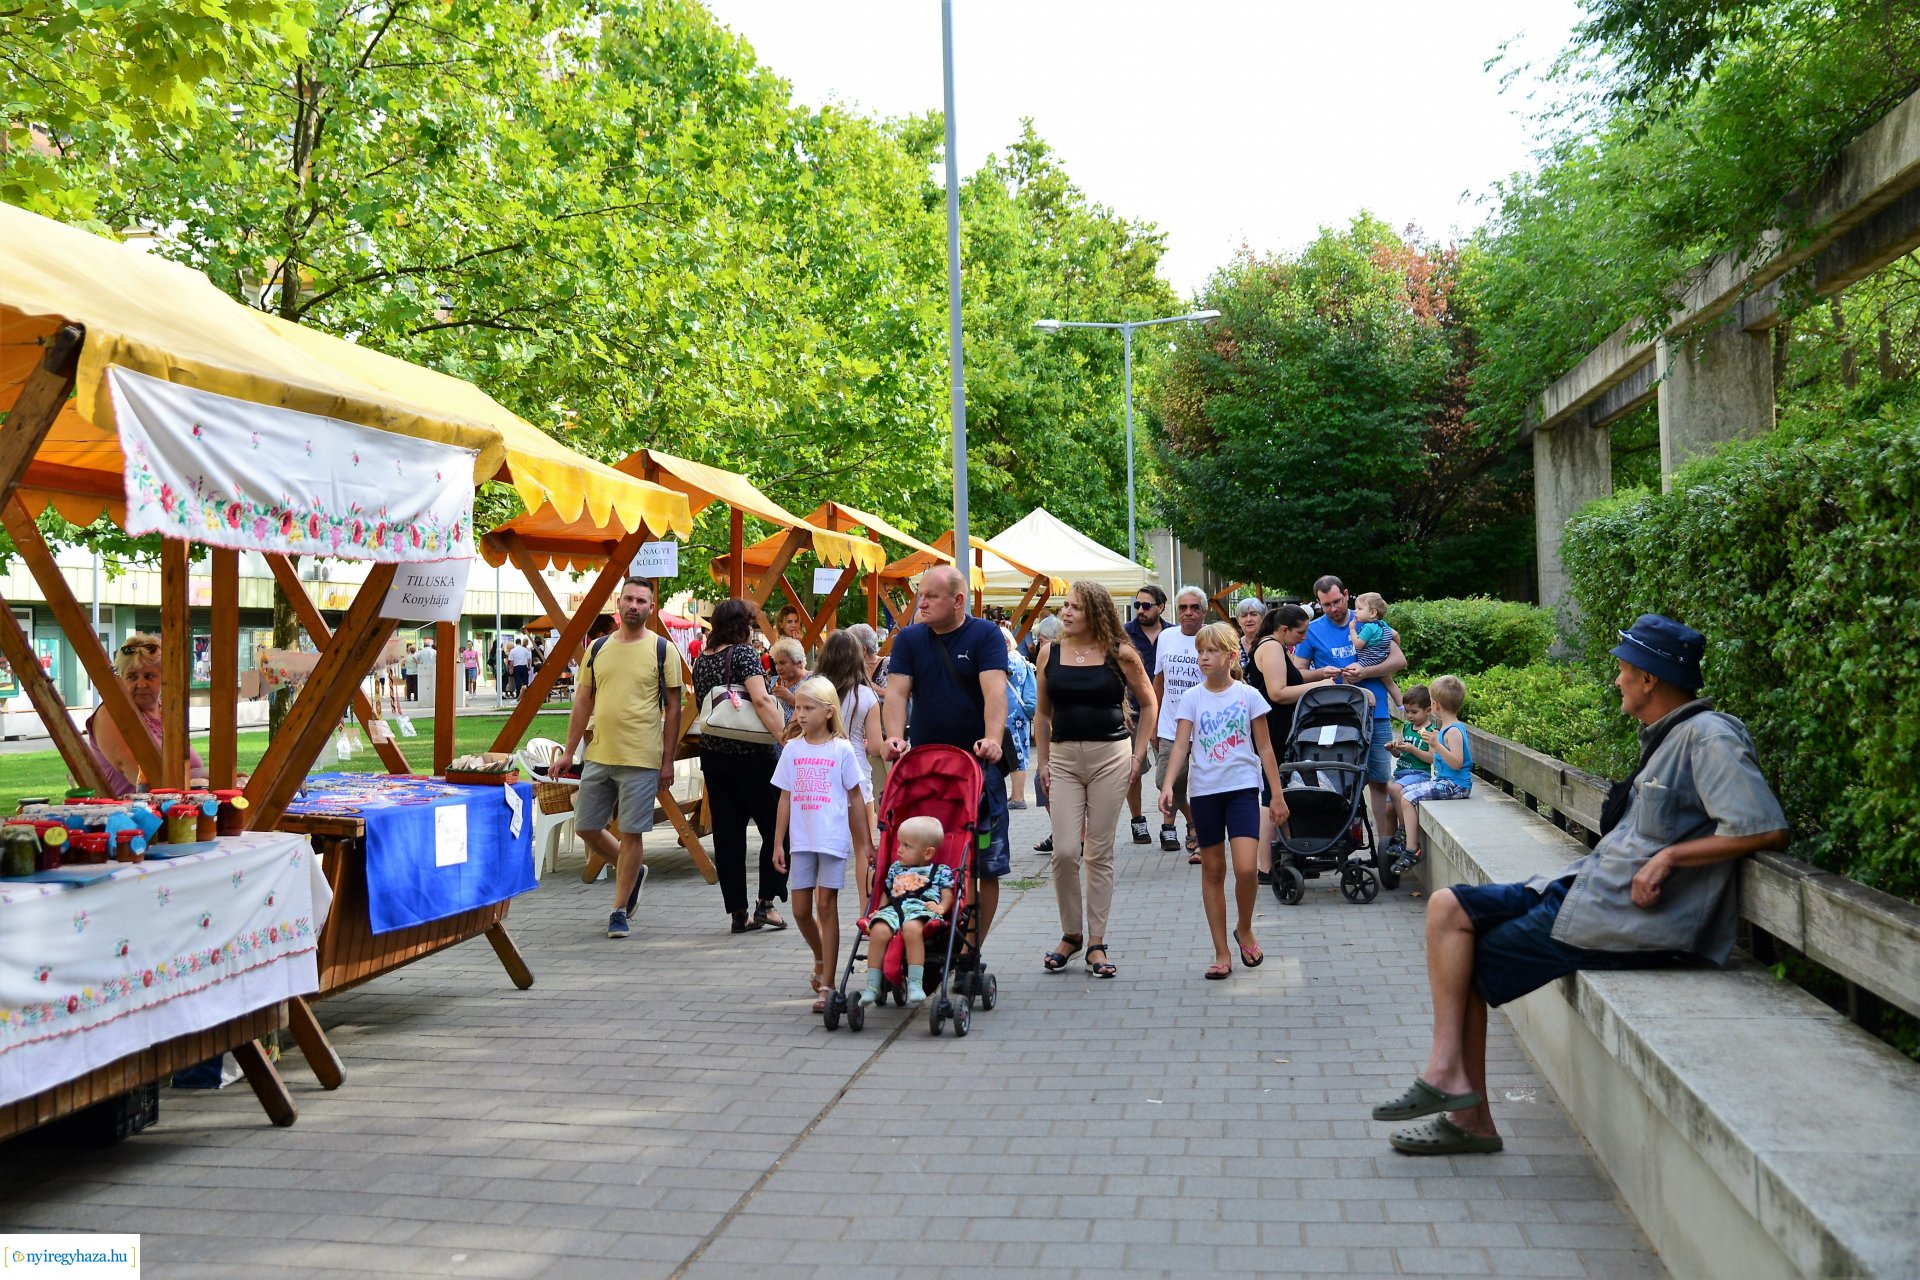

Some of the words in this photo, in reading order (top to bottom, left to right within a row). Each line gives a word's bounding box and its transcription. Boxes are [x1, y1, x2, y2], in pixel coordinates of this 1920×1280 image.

[643, 547, 670, 555] NAGYI
[407, 575, 455, 587] TILUSKA
[401, 593, 450, 608] Konyhája
[797, 767, 829, 780] DAS
[794, 780, 832, 793] WARS
